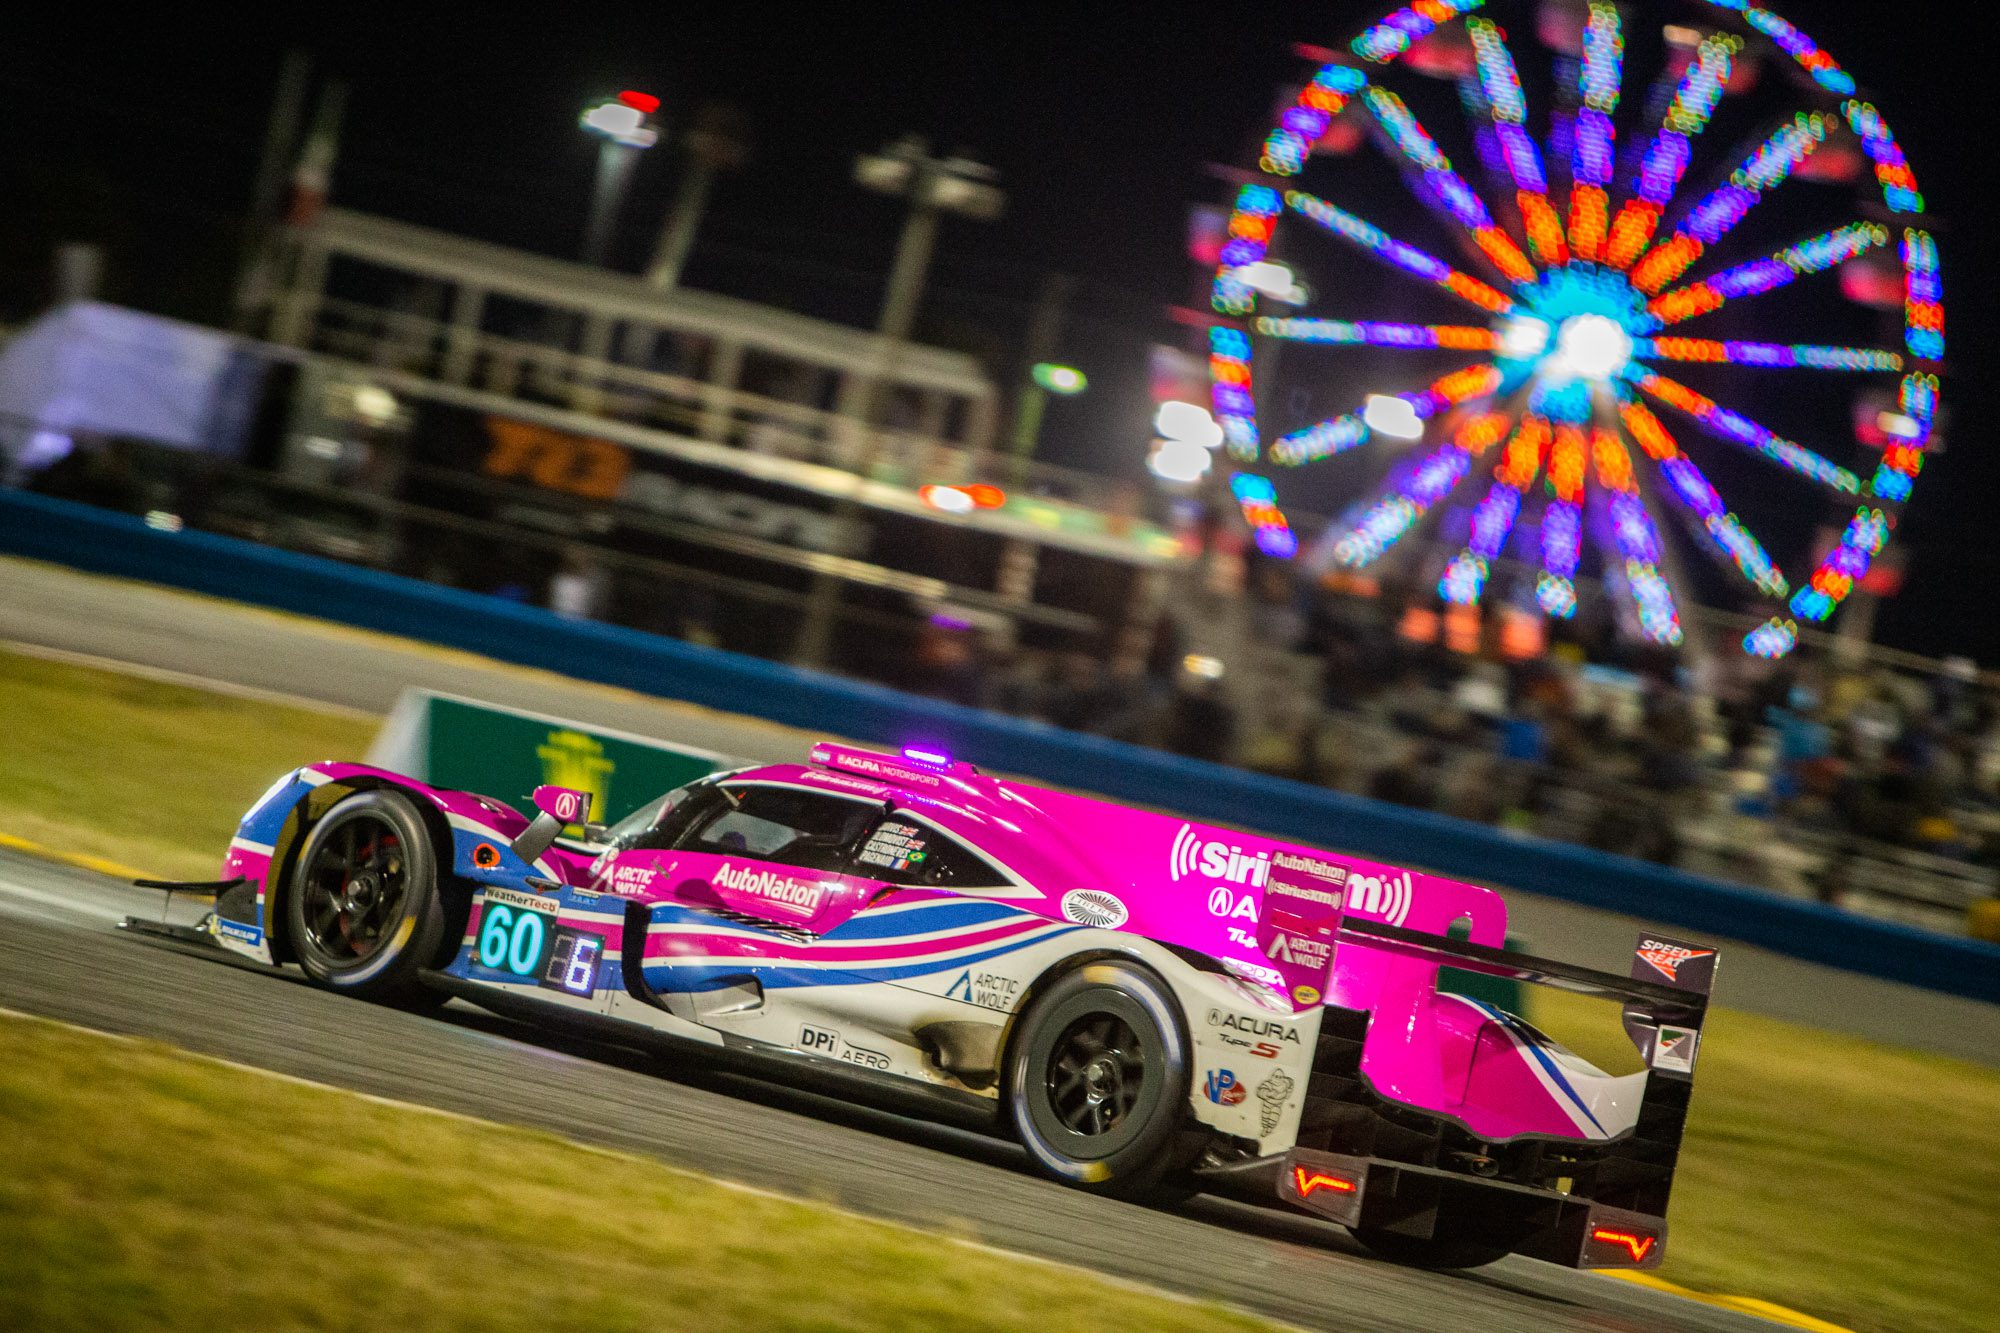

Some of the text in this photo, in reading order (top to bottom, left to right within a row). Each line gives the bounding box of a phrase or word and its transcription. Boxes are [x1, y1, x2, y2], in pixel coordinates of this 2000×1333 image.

[844, 756, 880, 772] ACURA
[882, 765, 940, 787] MOTORSPORTS
[614, 866, 657, 885] ARCTIC
[1272, 852, 1347, 880] AutoNation
[712, 862, 820, 908] AutoNation
[486, 889, 558, 912] WeatherTech
[479, 904, 545, 976] 60
[1289, 936, 1331, 958] ARCTIC
[1640, 939, 1692, 959] SPEED
[564, 937, 600, 992] 6
[1292, 951, 1326, 970] WOLF
[1645, 952, 1685, 968] SEAT
[974, 972, 1019, 995] ARCTIC
[977, 991, 1012, 1012] WOLF
[801, 1028, 836, 1053] DPi
[1222, 1013, 1301, 1045] ACURA
[841, 1050, 890, 1070] AERO
[1249, 1042, 1282, 1059] S
[1207, 1068, 1235, 1105] VP
